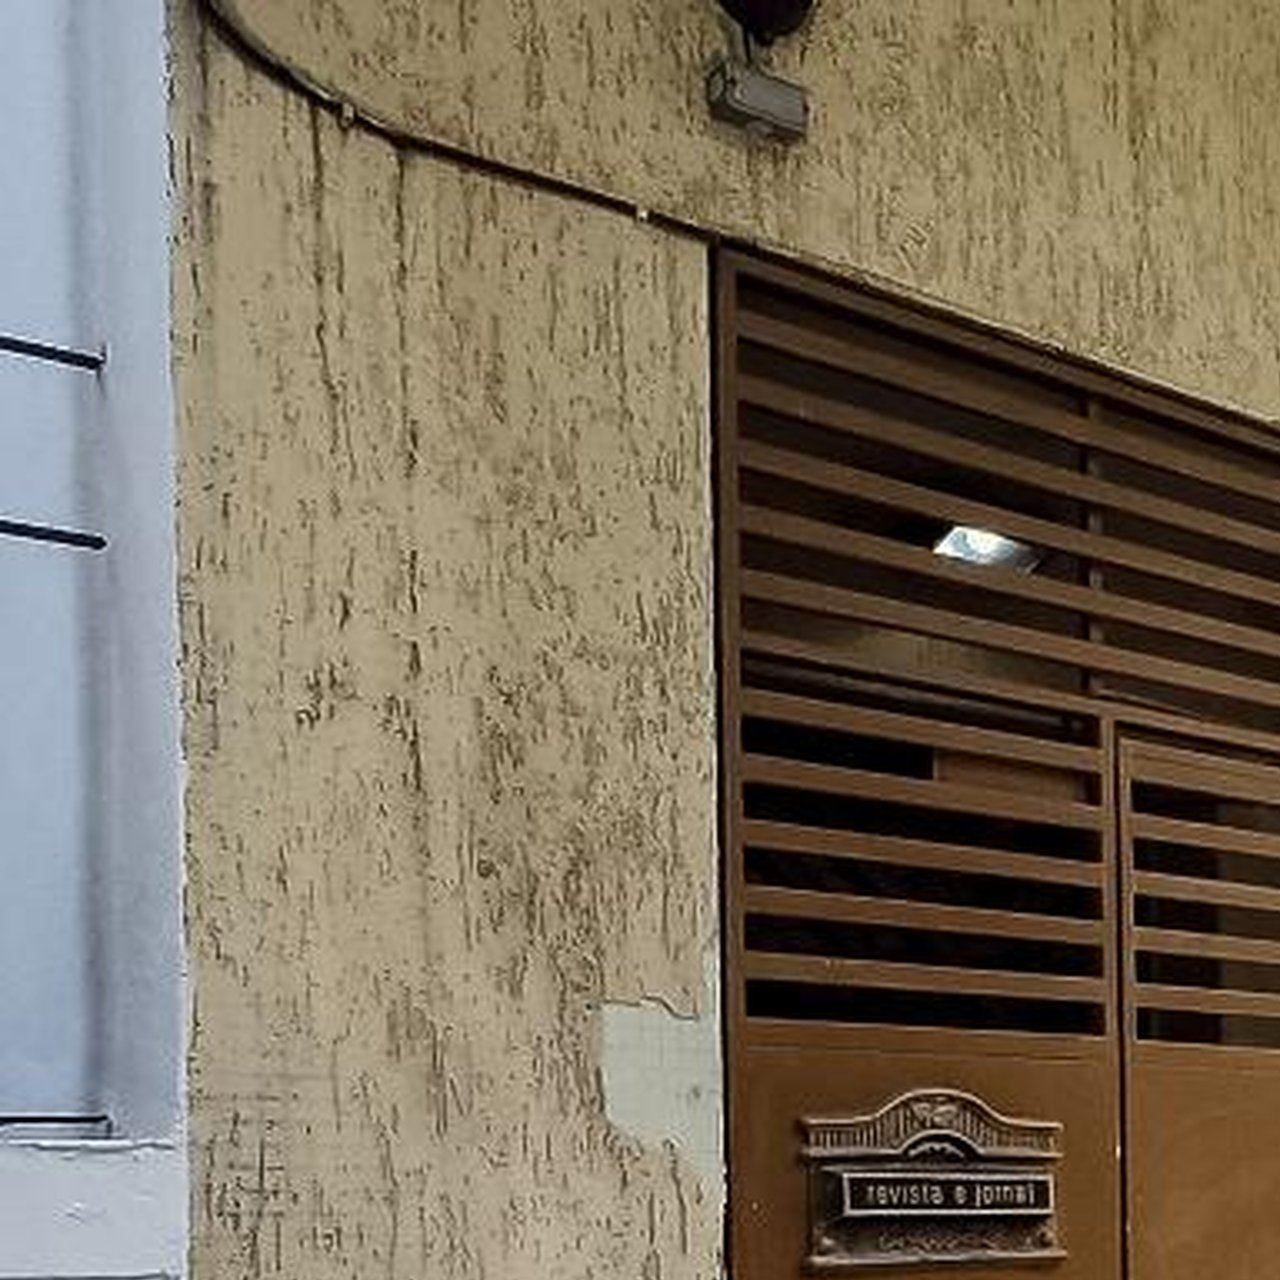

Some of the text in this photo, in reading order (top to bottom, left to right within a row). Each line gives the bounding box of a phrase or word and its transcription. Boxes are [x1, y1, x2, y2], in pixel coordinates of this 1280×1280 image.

[867, 1183, 1035, 1207] revista e jornal
